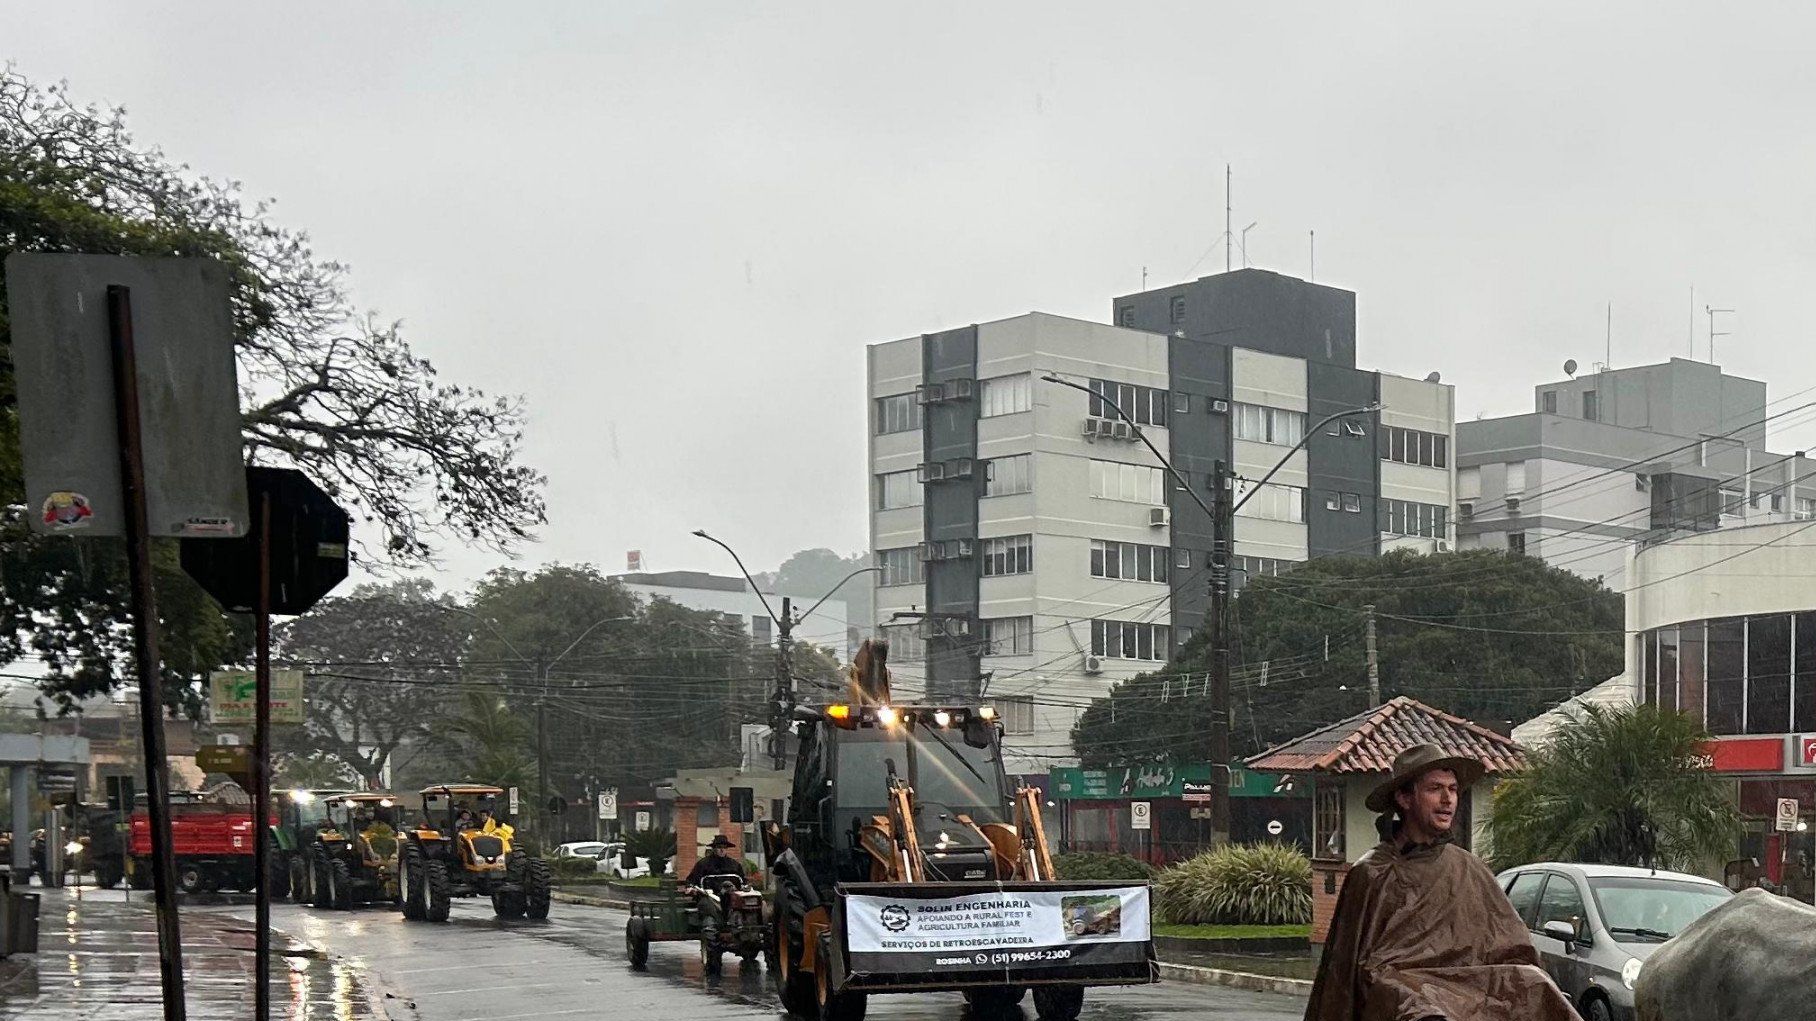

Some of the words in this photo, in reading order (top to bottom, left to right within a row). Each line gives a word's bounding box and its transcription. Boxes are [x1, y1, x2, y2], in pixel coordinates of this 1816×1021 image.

[956, 900, 1031, 911] ENGENHARIA
[917, 914, 963, 923] APOIANDO
[965, 913, 972, 921] A
[973, 911, 1003, 920] RURAL
[1004, 911, 1024, 919] FEST
[1026, 910, 1032, 918] E
[918, 921, 980, 931] AGRICULTURA
[981, 920, 1020, 929] FAMILIAR
[881, 940, 928, 950] SERVIÇOS
[930, 939, 941, 948] DE
[943, 936, 1034, 948] RETROESCAVADEIRA
[991, 952, 1010, 965] (51)
[1010, 949, 1071, 963] 99654-2300
